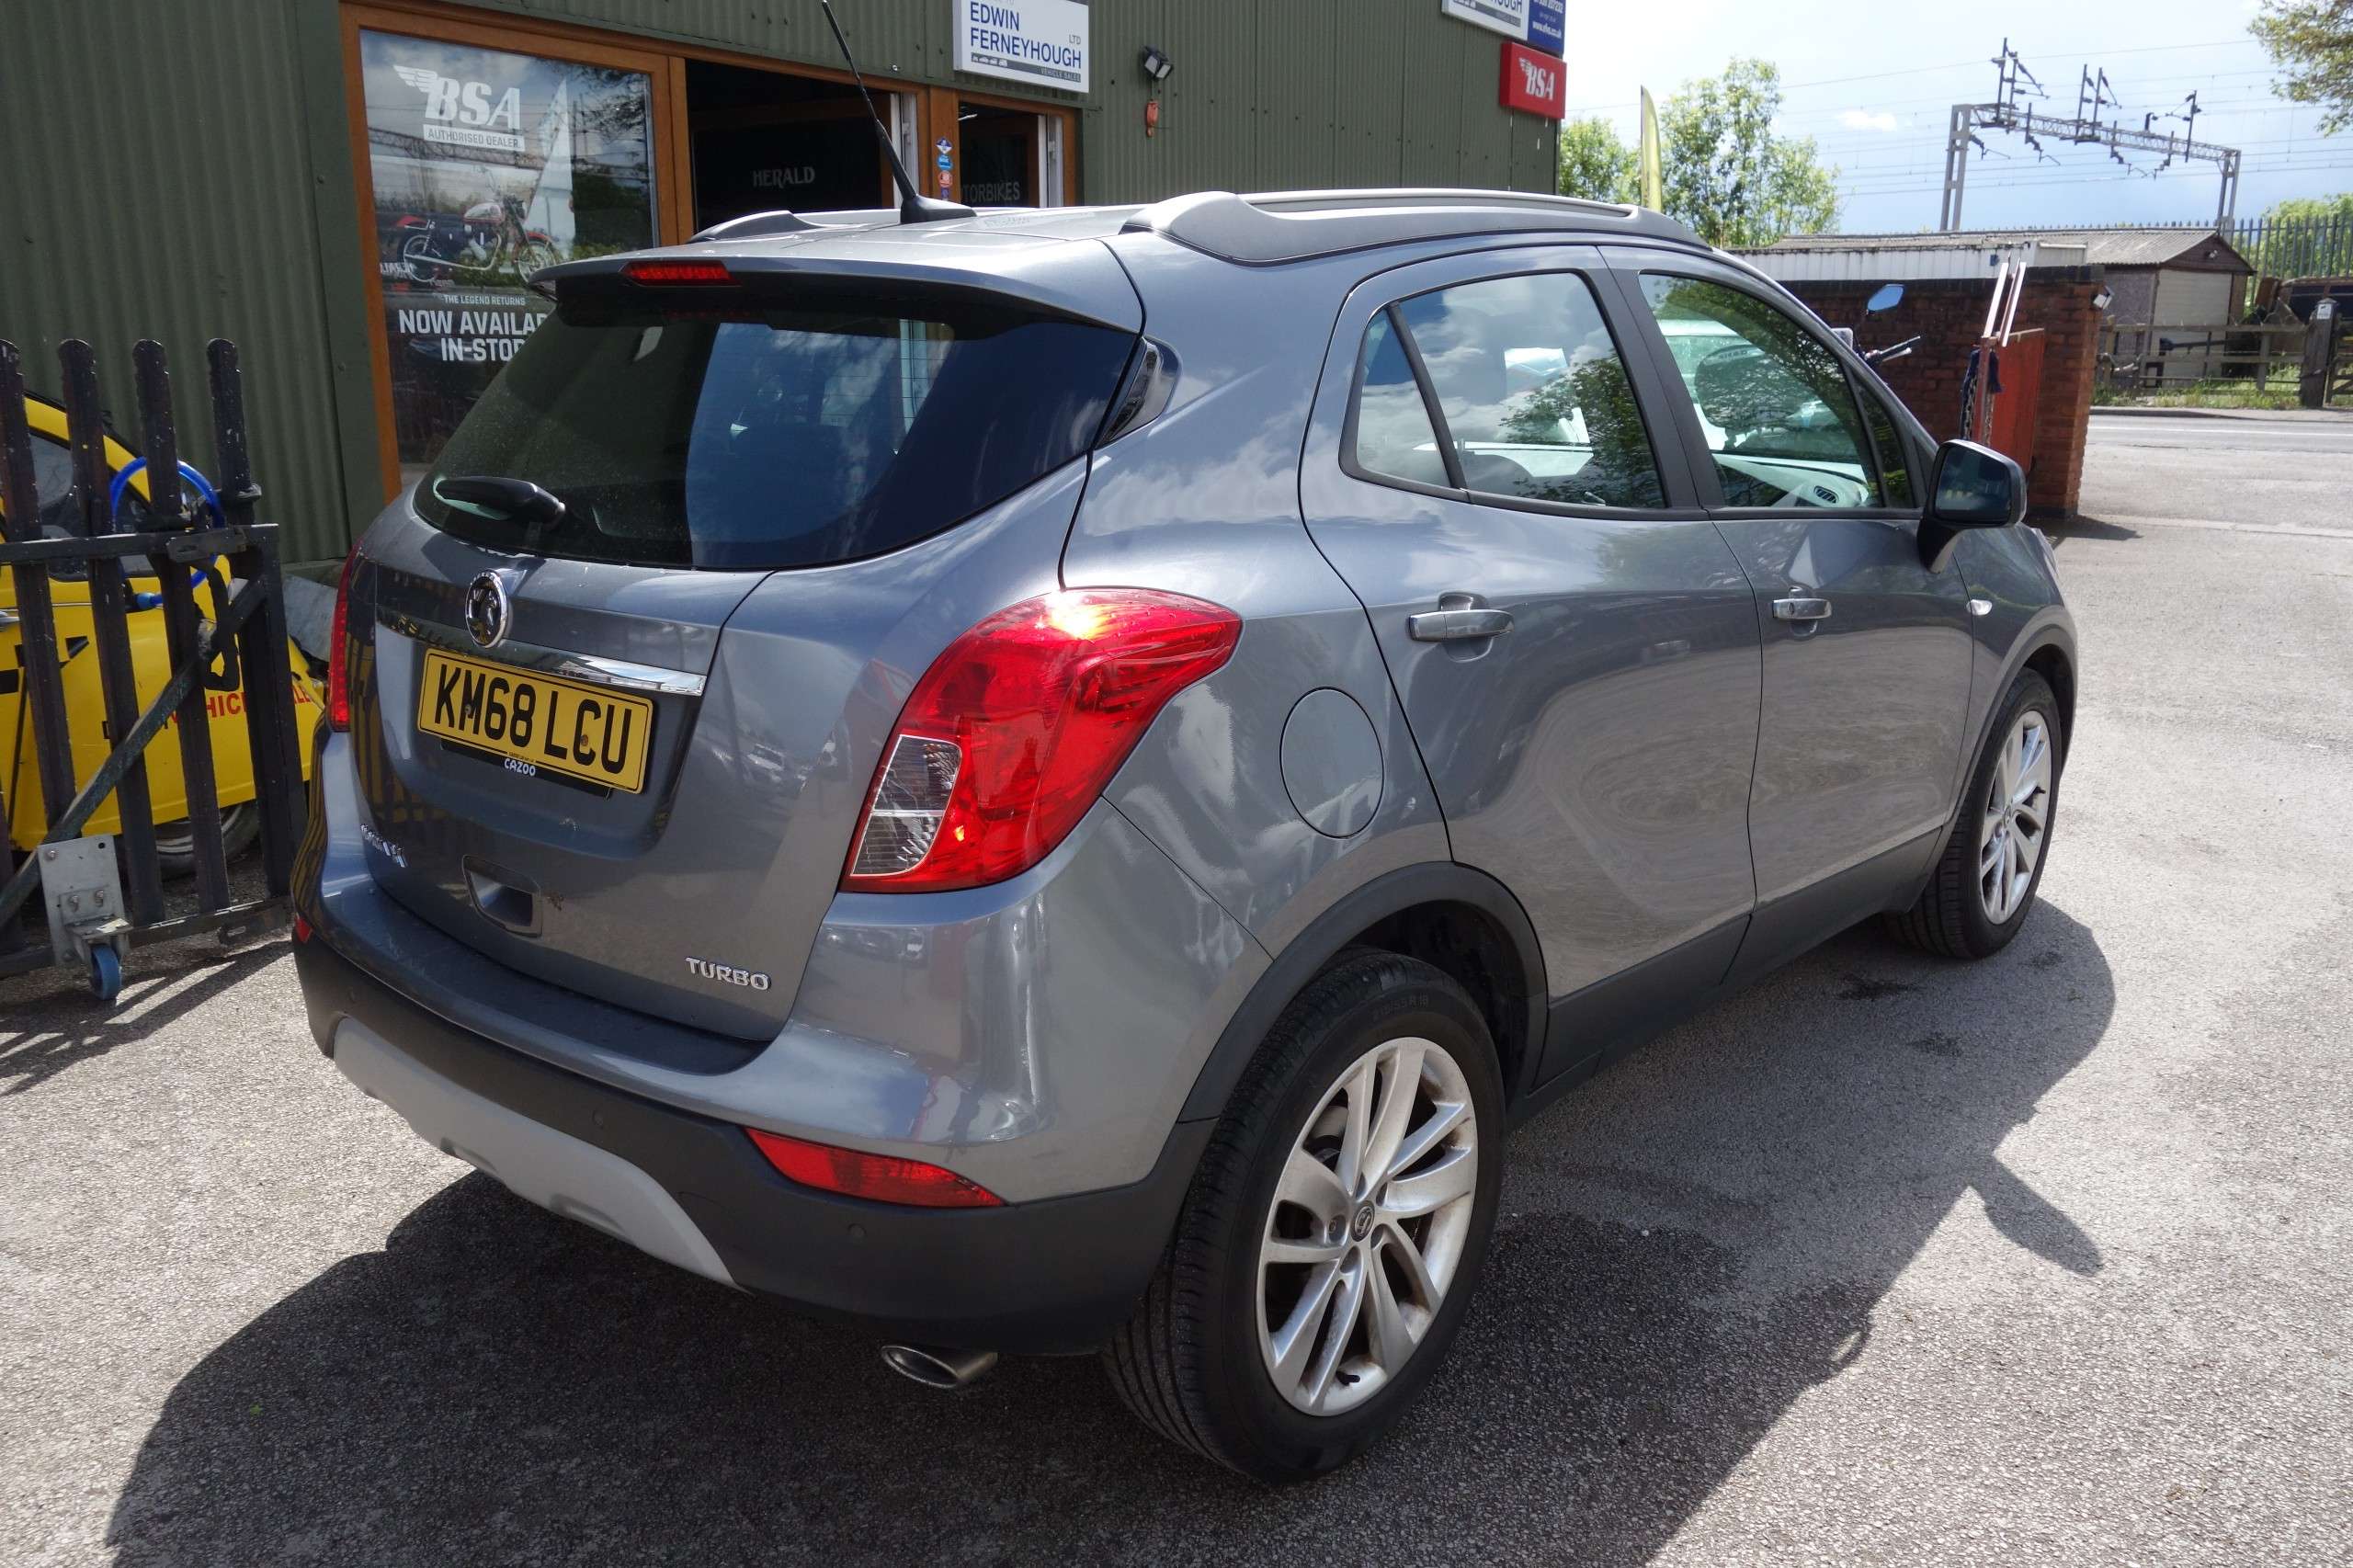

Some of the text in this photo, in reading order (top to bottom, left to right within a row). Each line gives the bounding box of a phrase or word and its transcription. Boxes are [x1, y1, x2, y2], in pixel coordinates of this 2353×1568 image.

[971, 2, 1019, 31] EDWIN
[971, 27, 1082, 69] FERNEYHOUGH
[1069, 34, 1081, 45] LTD
[1526, 65, 1555, 100] BSA
[425, 77, 521, 130] BSA
[427, 129, 518, 148] AUTHORISED DEALER
[753, 166, 815, 188] HERALD
[445, 295, 526, 306] THE LEGEND RETURNS
[399, 309, 453, 335] NOW
[434, 664, 632, 775] KM68 LCU
[504, 758, 536, 777] CAZOO
[686, 957, 771, 991] TURBO
